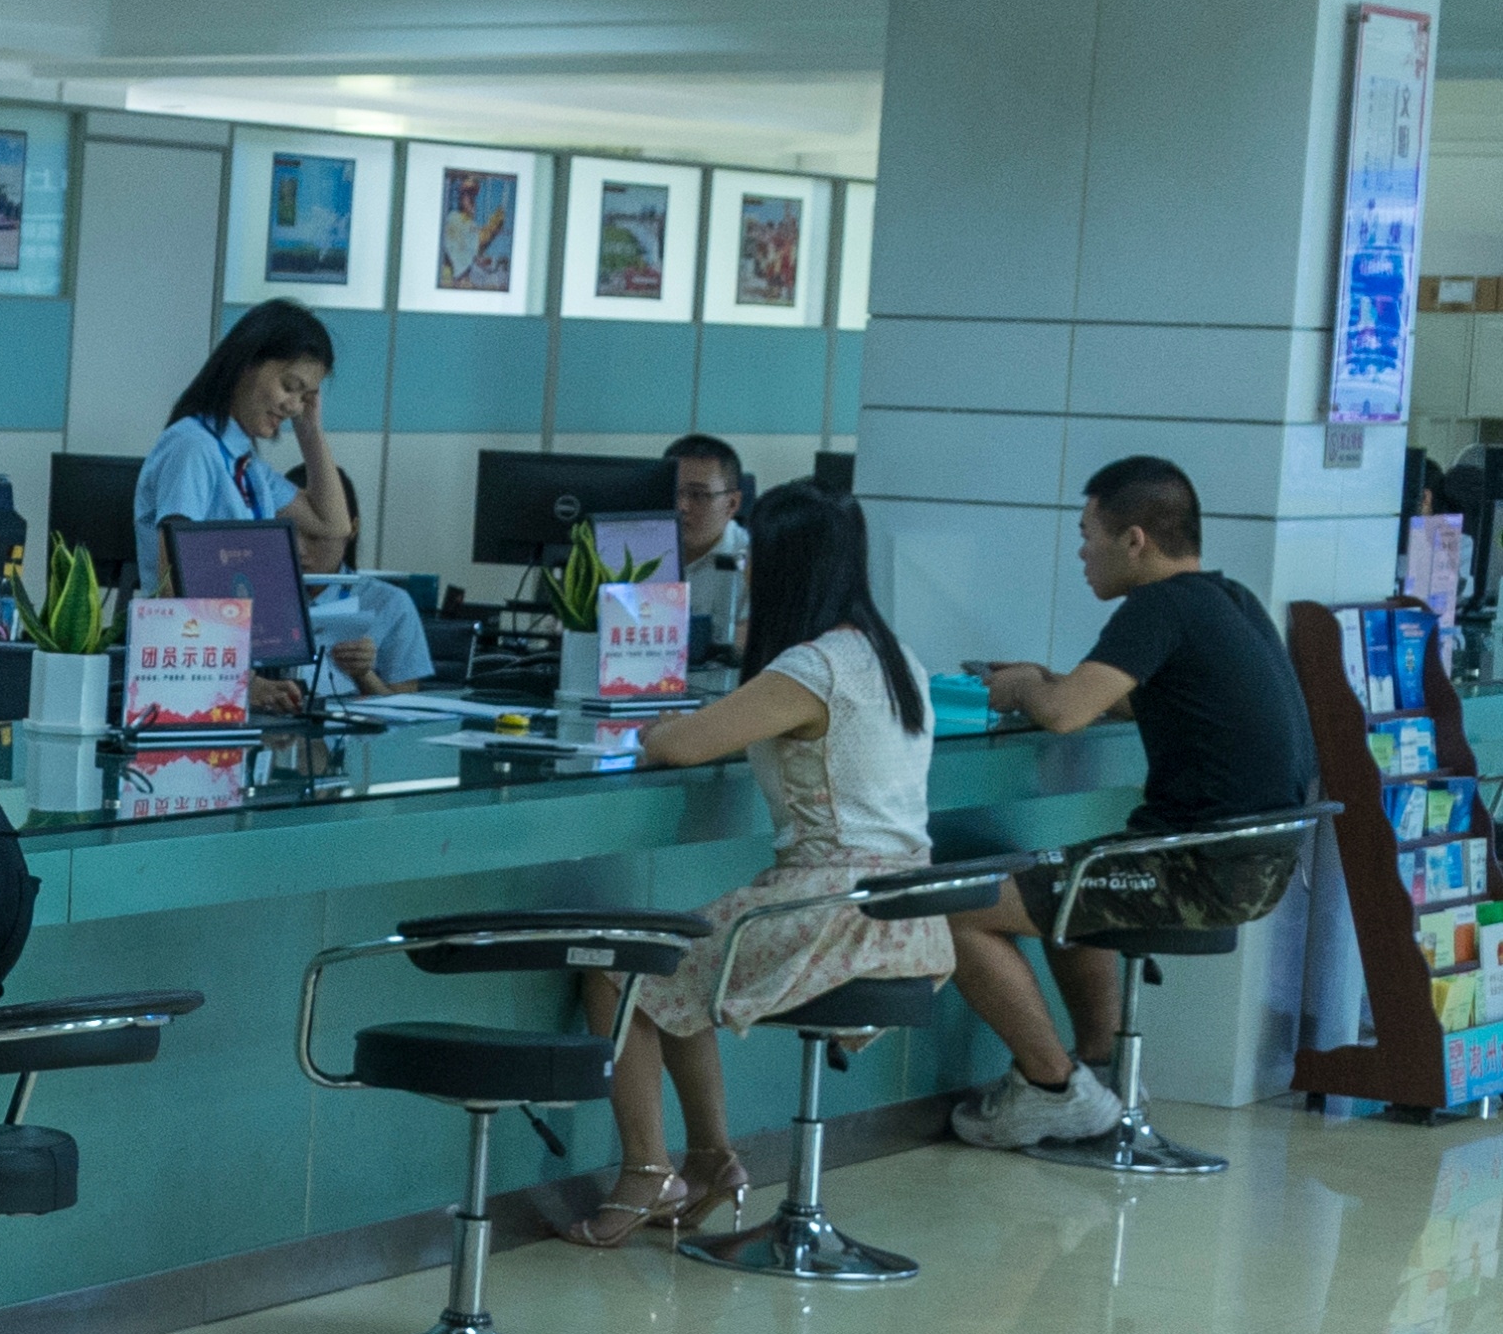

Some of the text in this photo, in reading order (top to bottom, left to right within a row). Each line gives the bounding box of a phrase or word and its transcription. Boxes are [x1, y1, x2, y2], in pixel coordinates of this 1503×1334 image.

[141, 646, 237, 669] 团员示范岗
